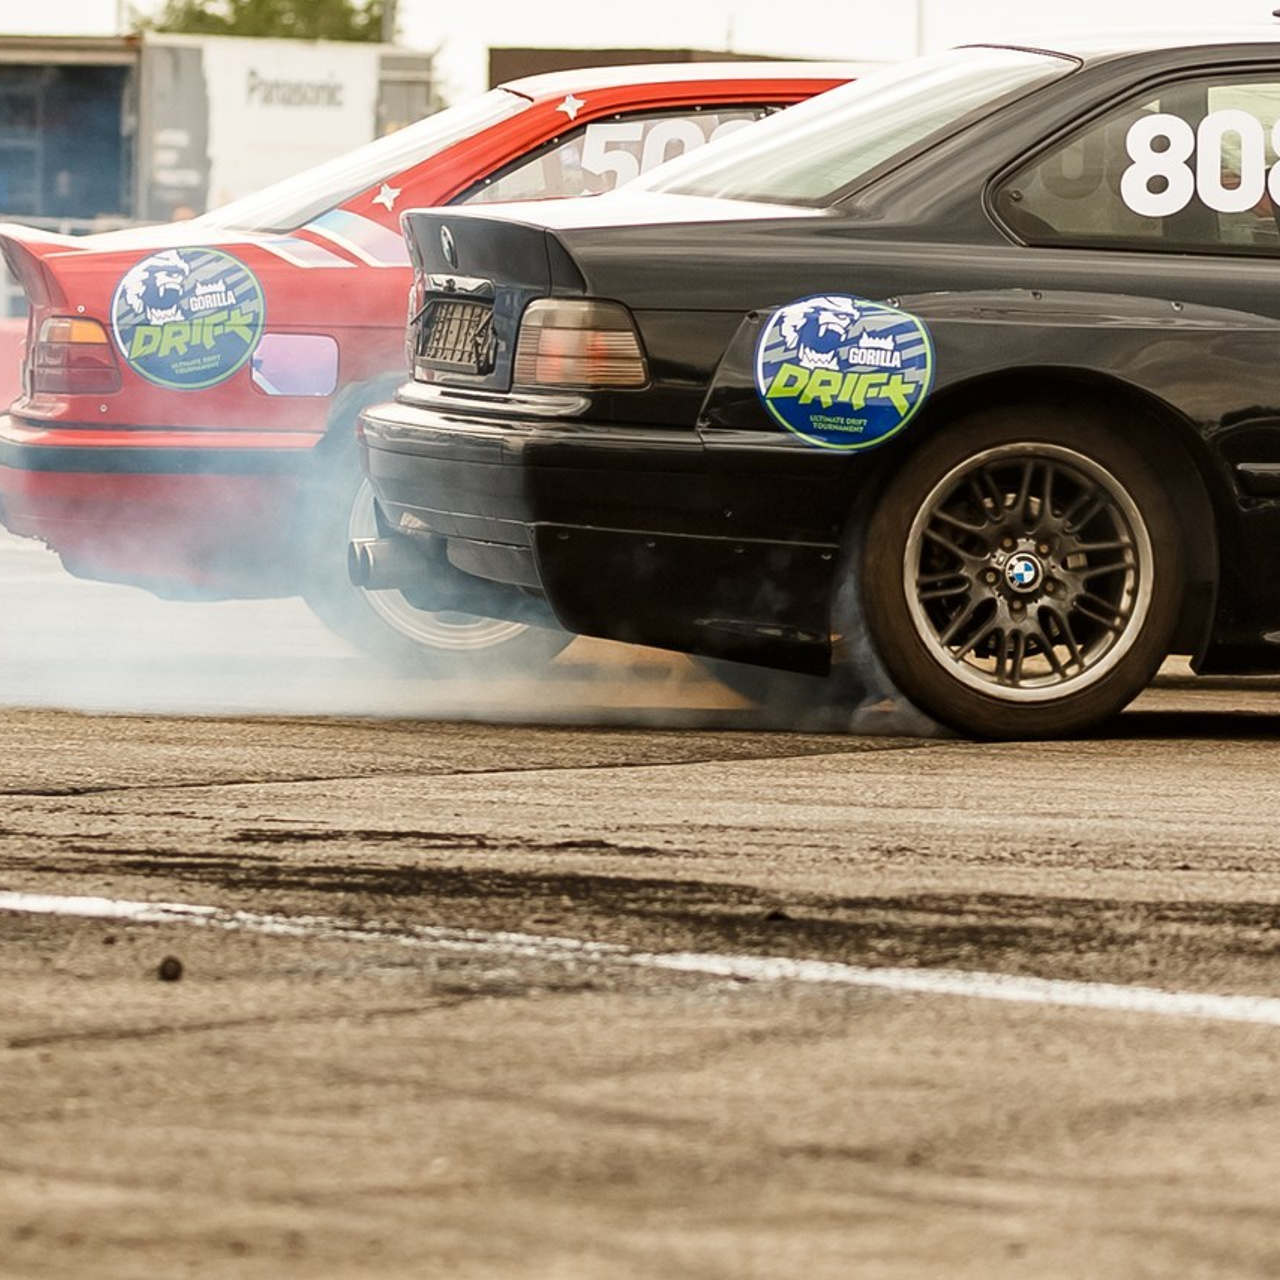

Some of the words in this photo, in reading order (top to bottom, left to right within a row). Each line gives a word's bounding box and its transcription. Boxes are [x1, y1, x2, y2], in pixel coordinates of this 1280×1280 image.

[247, 66, 344, 108] Panasonic
[580, 119, 757, 196] 50
[189, 290, 236, 312] GORILLA
[849, 347, 901, 368] GORILLA
